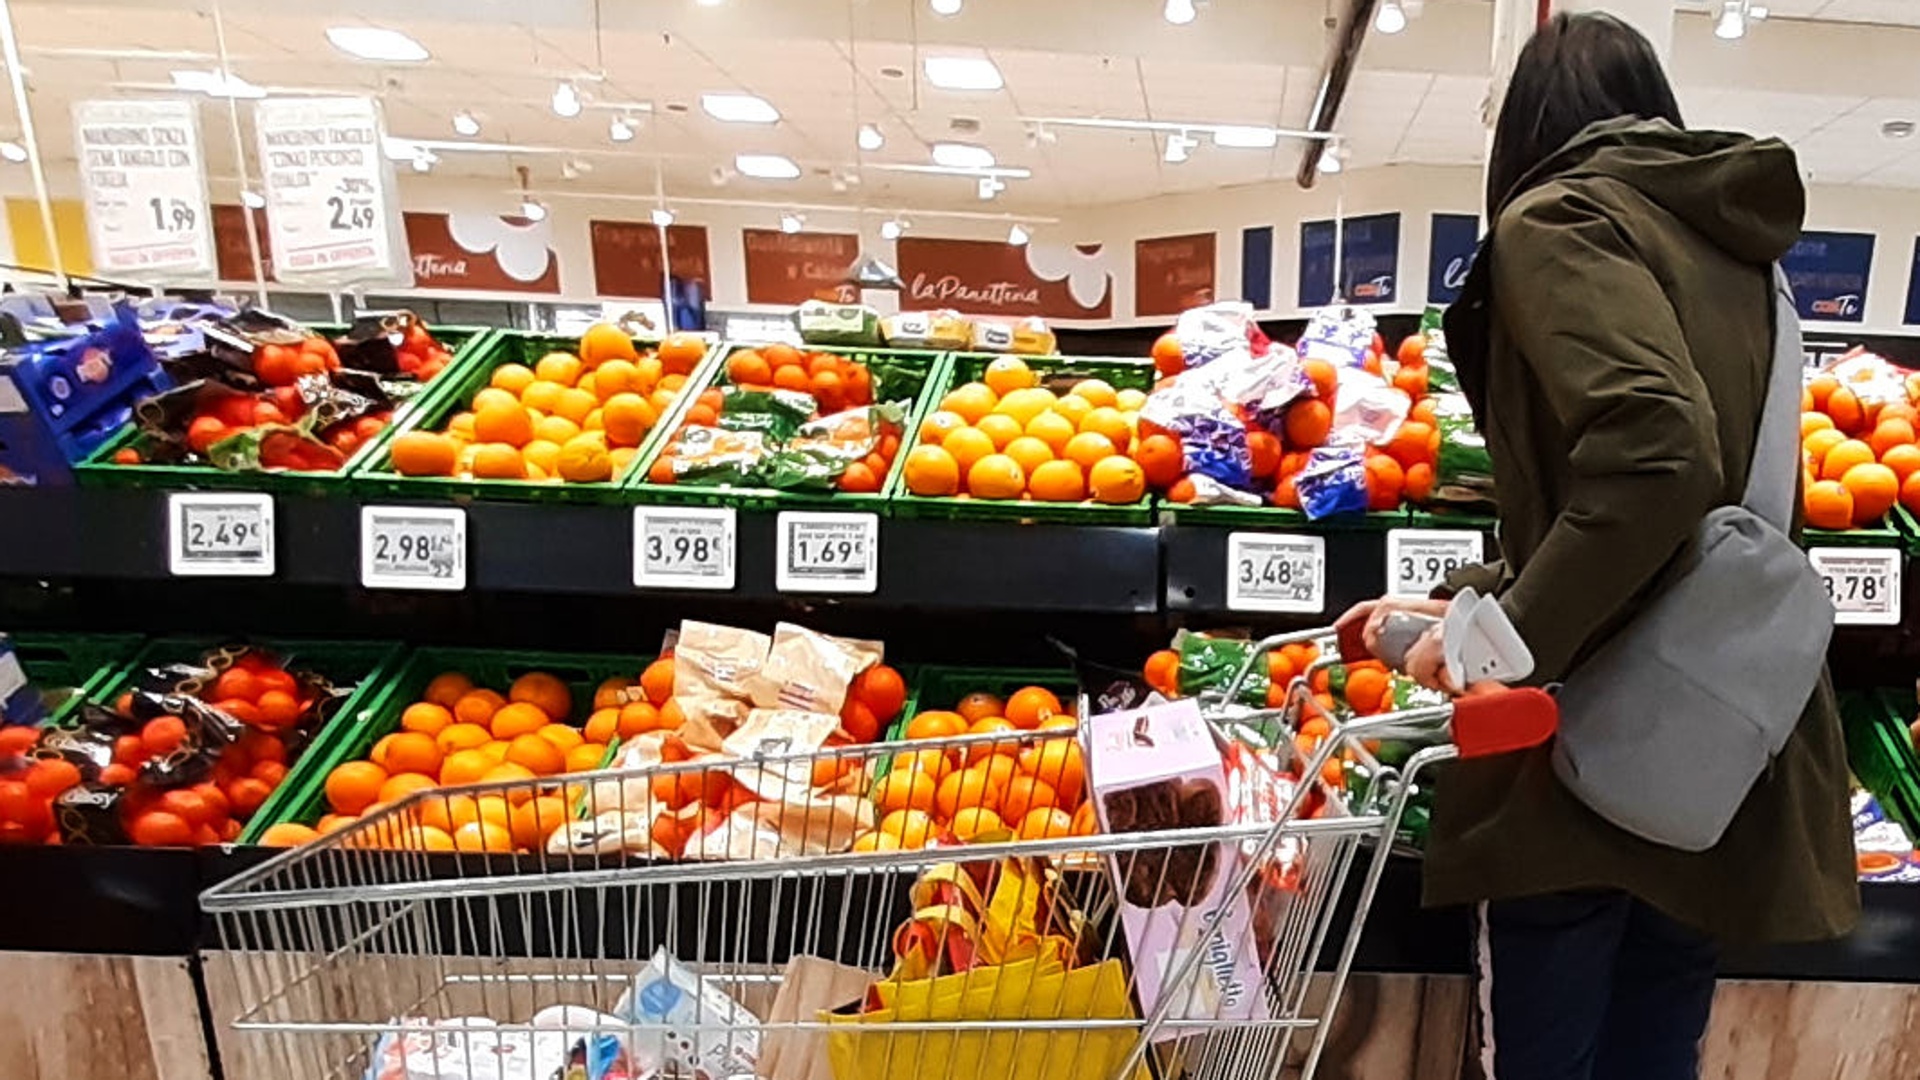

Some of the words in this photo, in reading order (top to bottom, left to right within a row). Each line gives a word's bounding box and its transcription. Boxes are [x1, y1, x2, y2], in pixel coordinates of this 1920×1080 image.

[151, 198, 196, 232] 1,99
[375, 534, 431, 563] 2,98
[647, 535, 720, 564] 3,98€
[799, 541, 863, 563] 1,69€
[1240, 558, 1292, 586] 3,48
